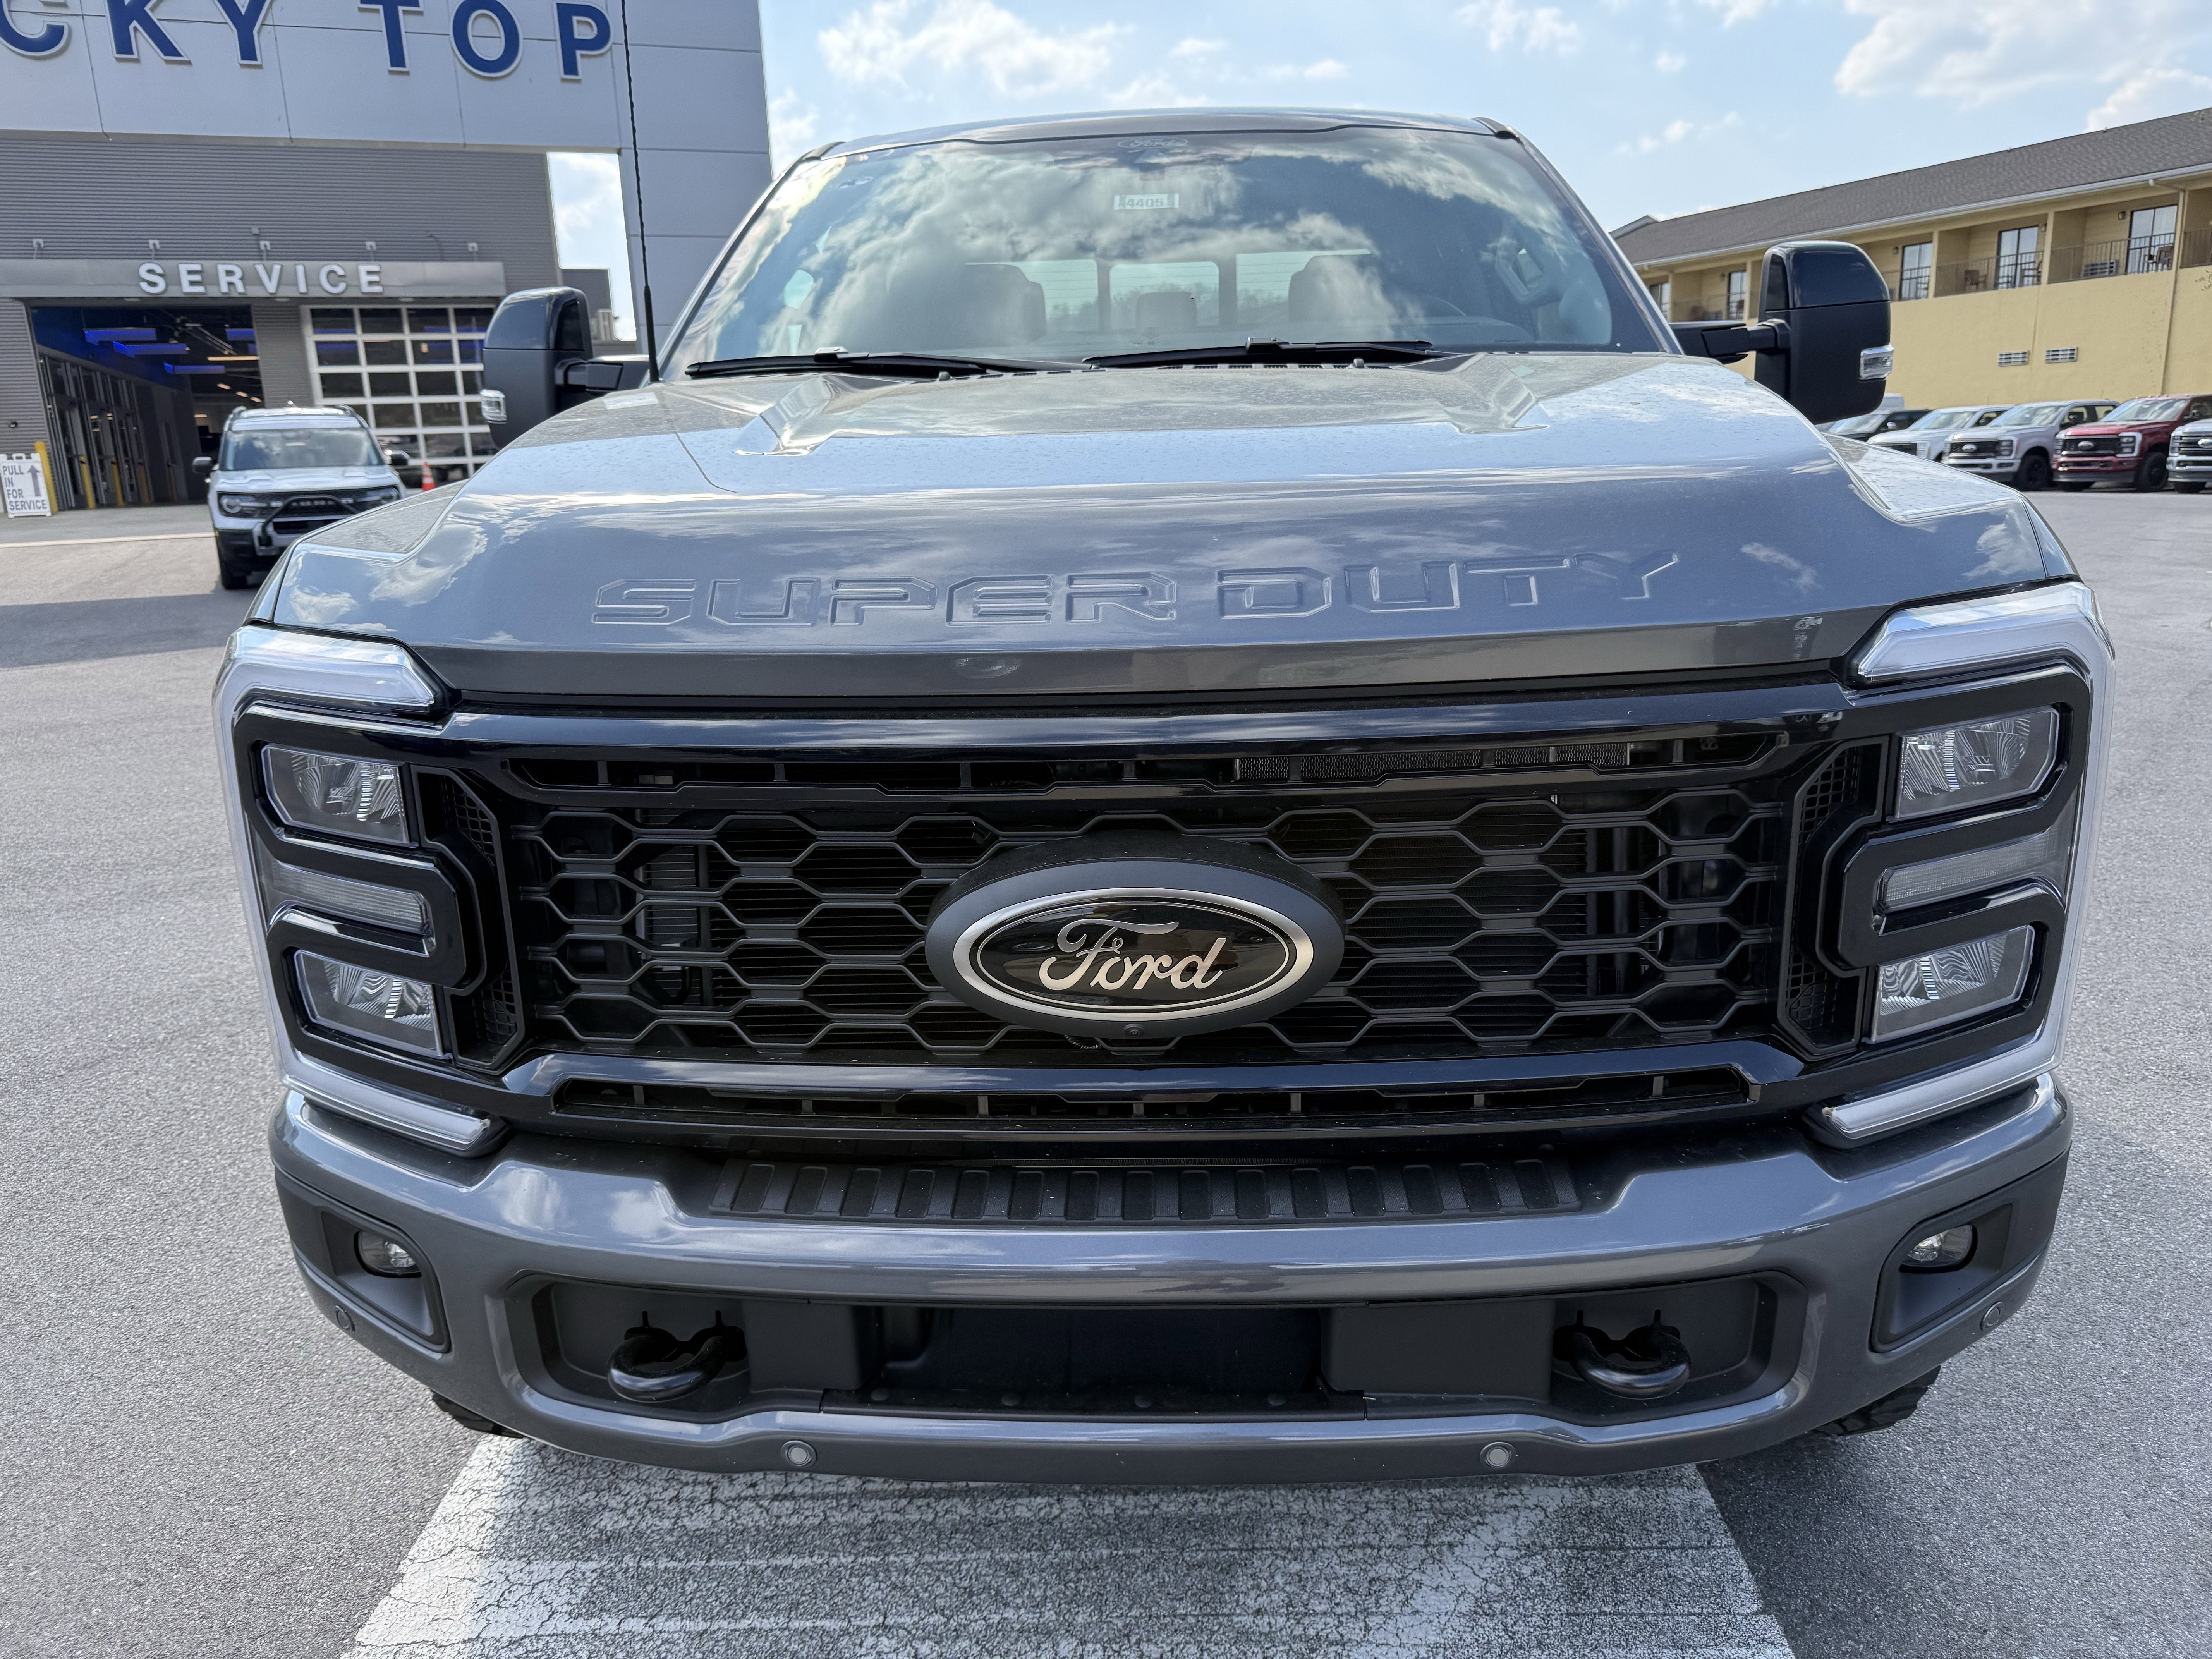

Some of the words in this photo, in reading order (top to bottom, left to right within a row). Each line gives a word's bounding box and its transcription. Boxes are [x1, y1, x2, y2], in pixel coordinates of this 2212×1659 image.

[357, 0, 613, 79] TOP
[1126, 198, 1164, 208] 4405
[138, 262, 384, 295] SERVICE
[2, 465, 24, 476] PULL
[4, 477, 14, 487] IN
[7, 489, 24, 499] FOR
[9, 500, 47, 510] SERVICE
[591, 571, 1177, 627] SUPER
[1217, 553, 1679, 620] DUTY
[1039, 918, 1223, 991] Ford
